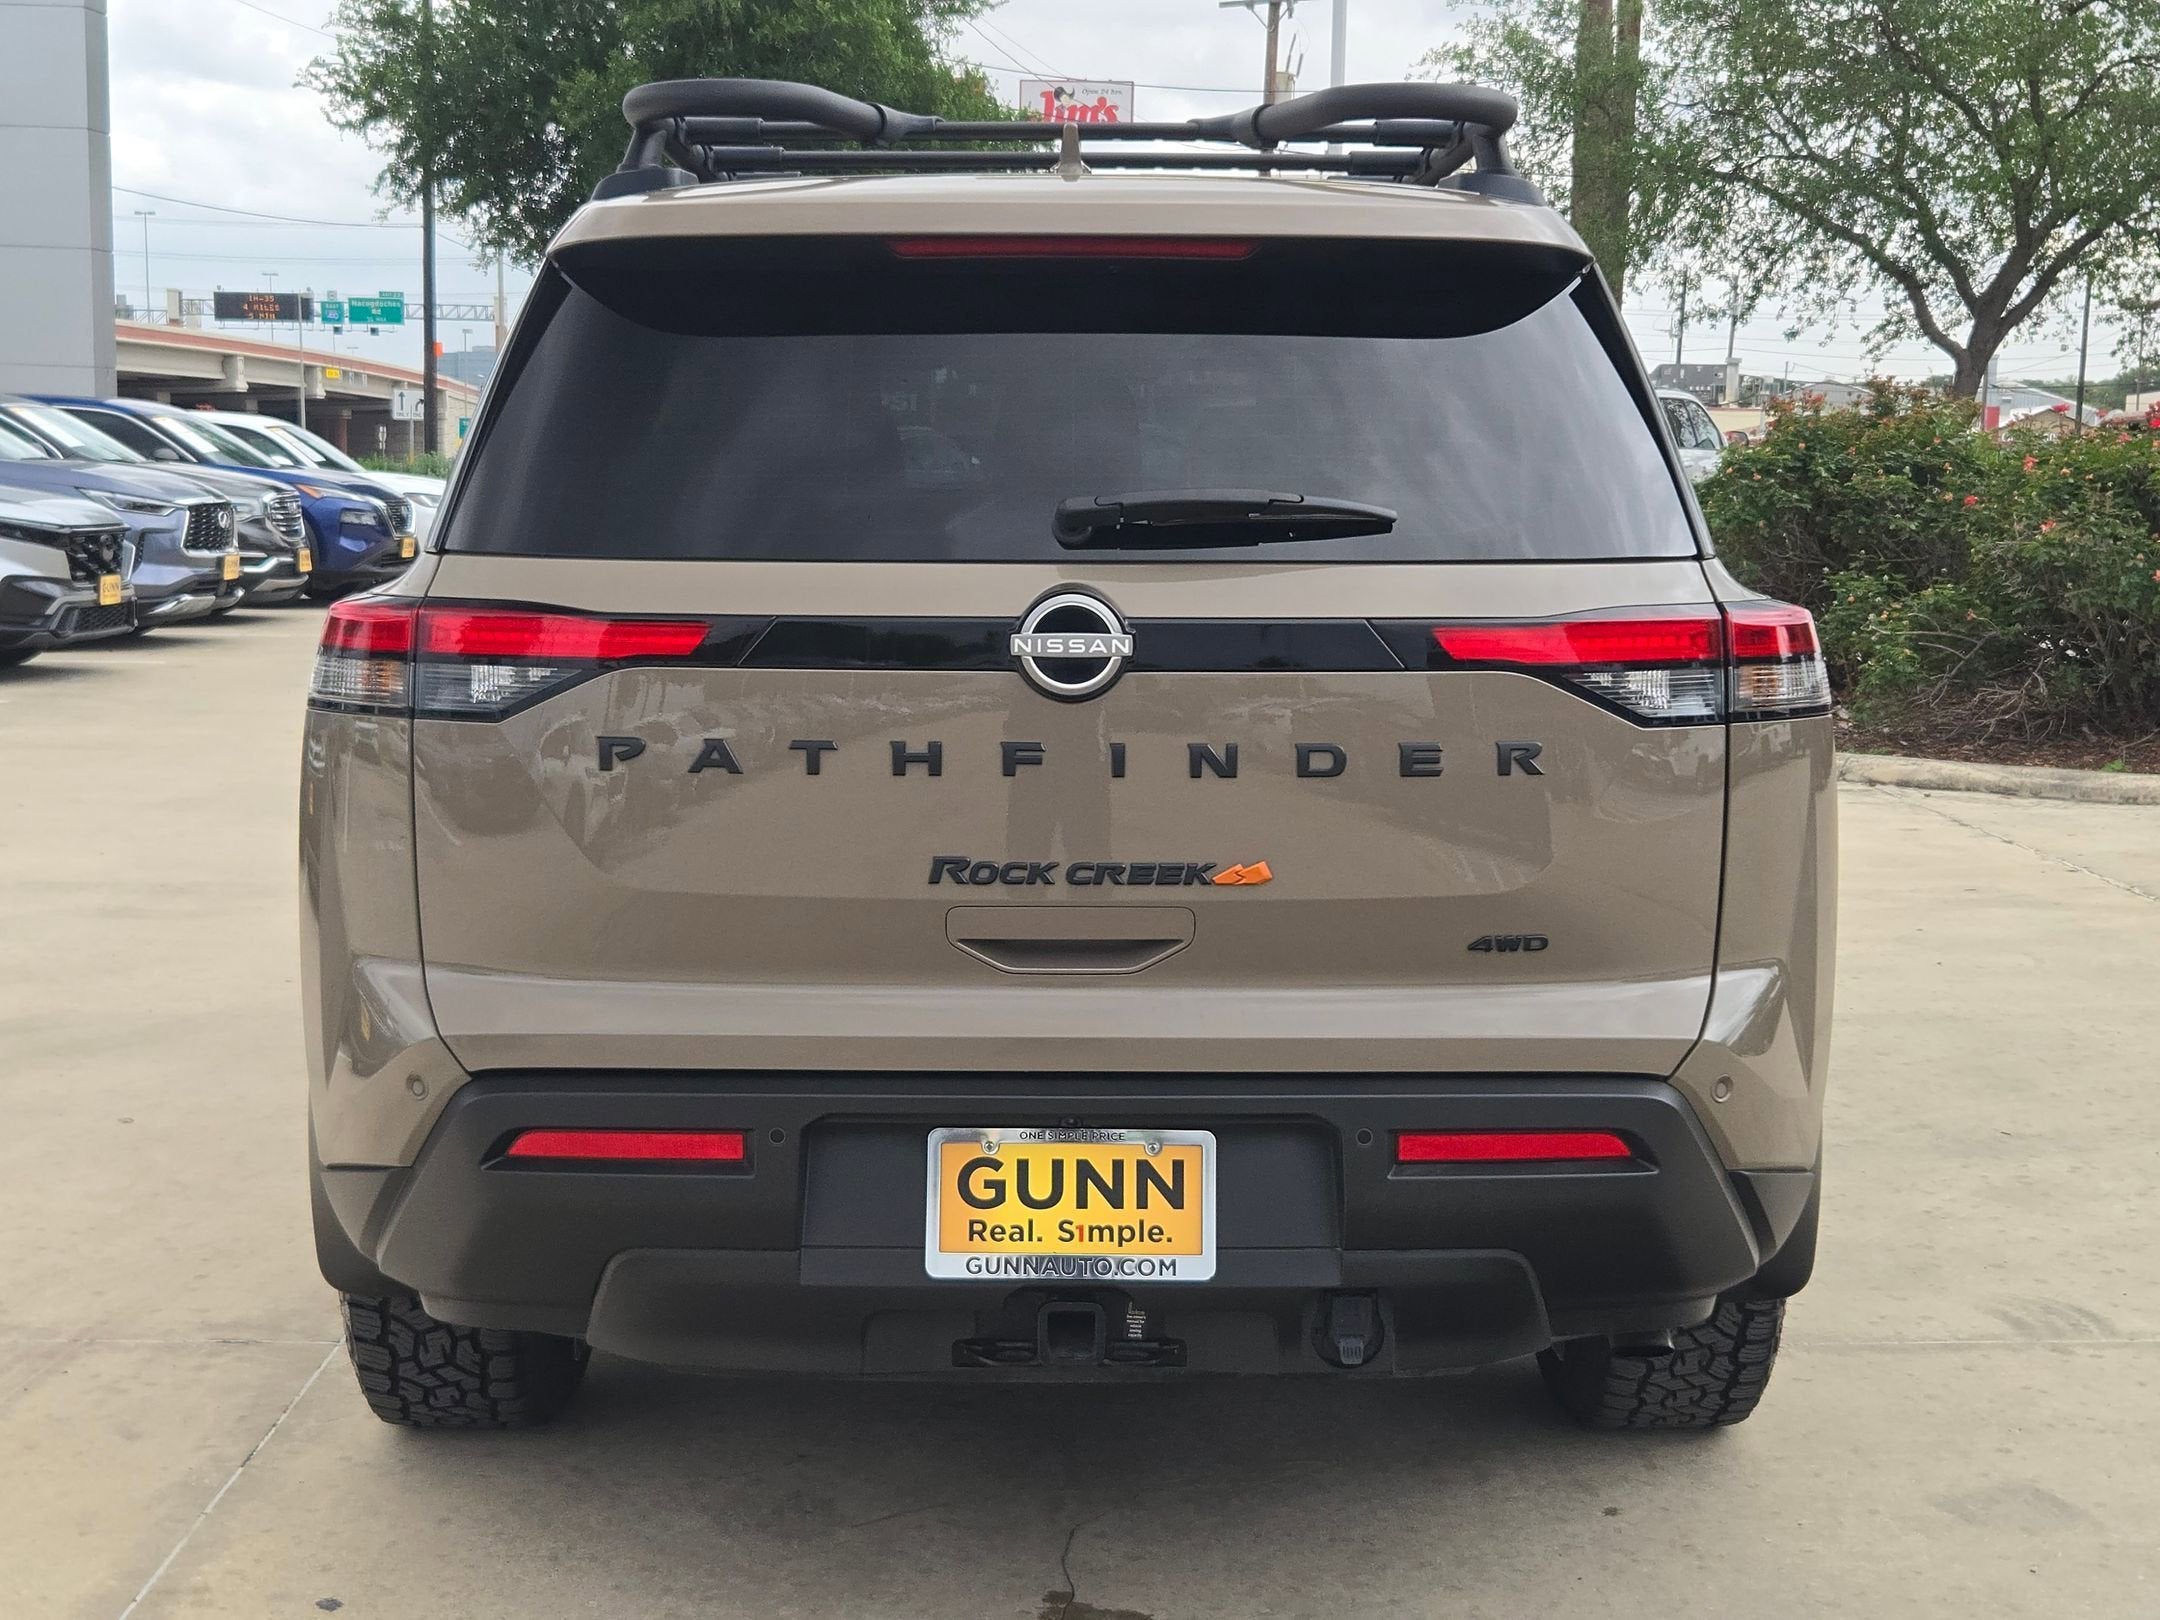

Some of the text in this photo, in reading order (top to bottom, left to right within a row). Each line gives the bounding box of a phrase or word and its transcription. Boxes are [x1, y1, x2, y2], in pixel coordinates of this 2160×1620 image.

[1081, 88, 1099, 97] Open
[1014, 638, 1129, 653] NISSAN
[596, 735, 1545, 778] PATHFINDER
[928, 856, 1217, 886] ROCK CREEK
[1467, 934, 1549, 952] 4WD
[1019, 1130, 1126, 1141] ONE SIMPLE PRICE
[957, 1156, 1185, 1211] GUNN
[967, 1218, 1173, 1248] Real. S1mple.
[965, 1256, 1178, 1277] GUNNAUTO.COM
